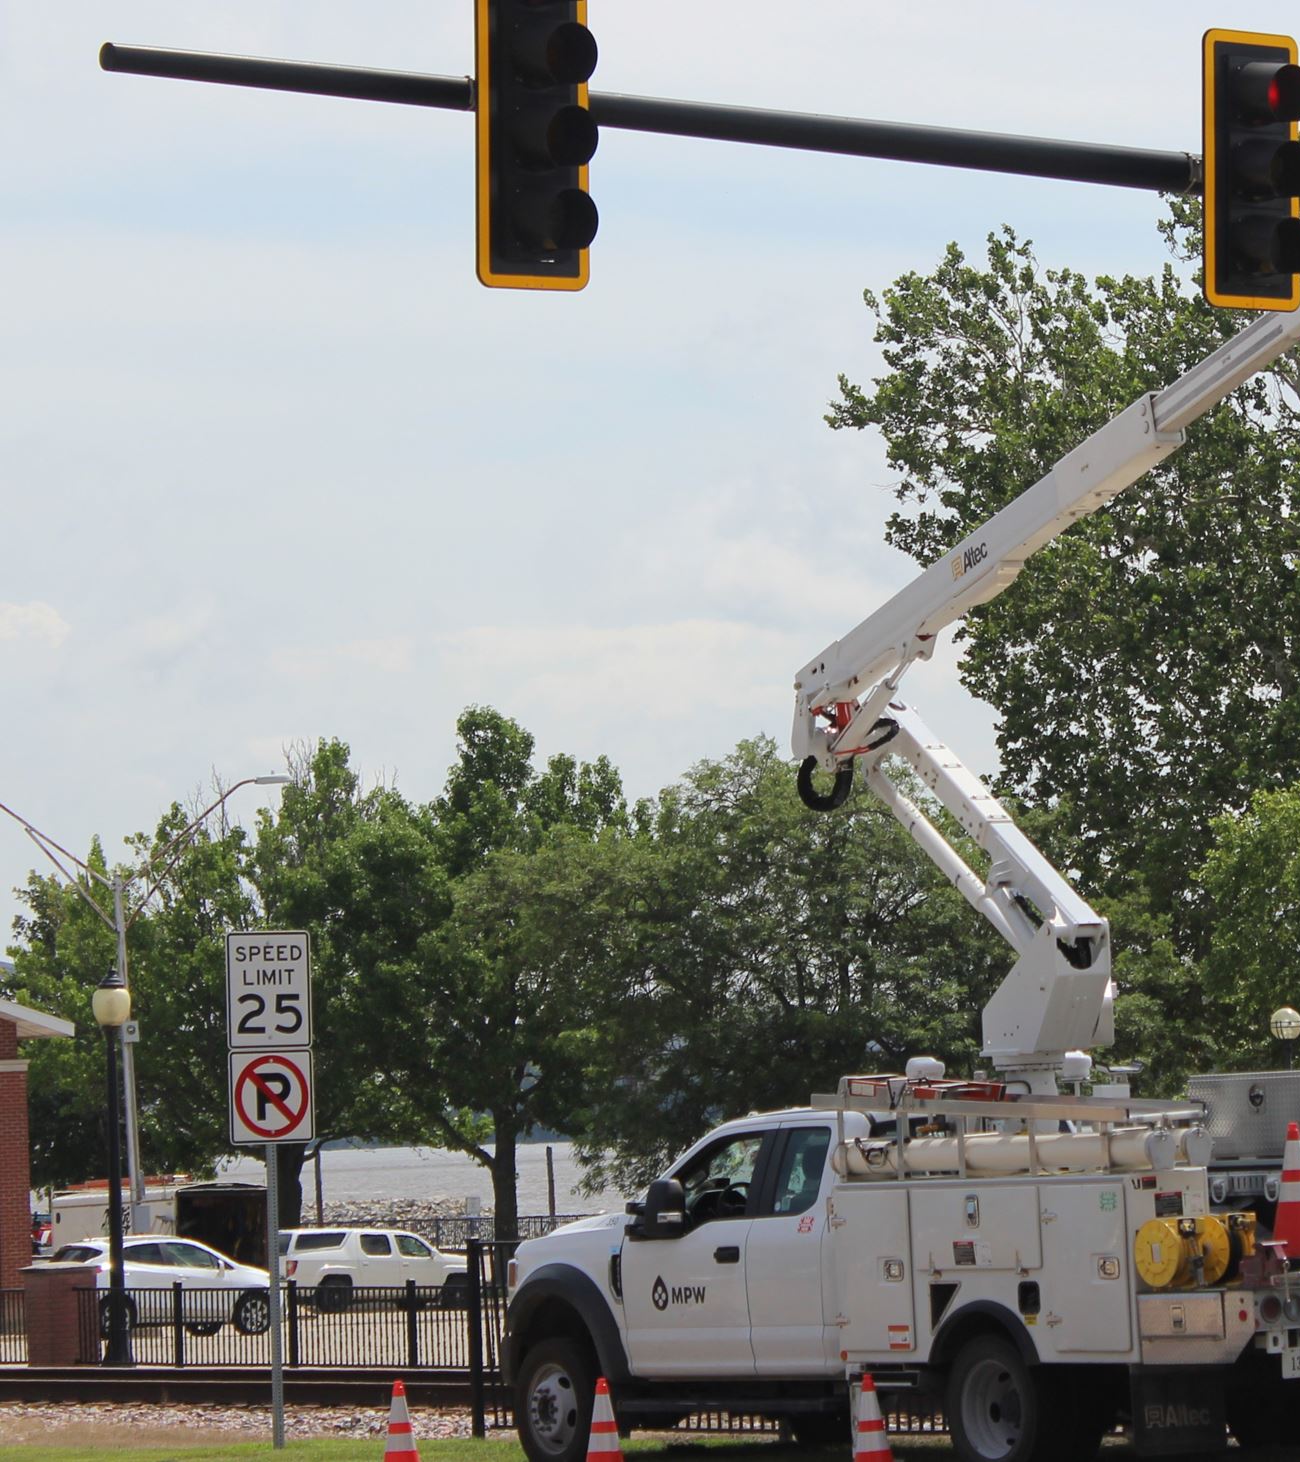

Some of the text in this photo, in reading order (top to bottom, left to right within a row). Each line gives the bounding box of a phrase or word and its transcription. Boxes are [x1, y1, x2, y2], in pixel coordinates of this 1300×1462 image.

[963, 542, 988, 574] Altec
[235, 945, 303, 962] SPEED
[242, 969, 295, 986] LIMIT
[237, 993, 303, 1035] 25
[671, 1286, 706, 1305] MPW
[1165, 1404, 1210, 1428] Altec
